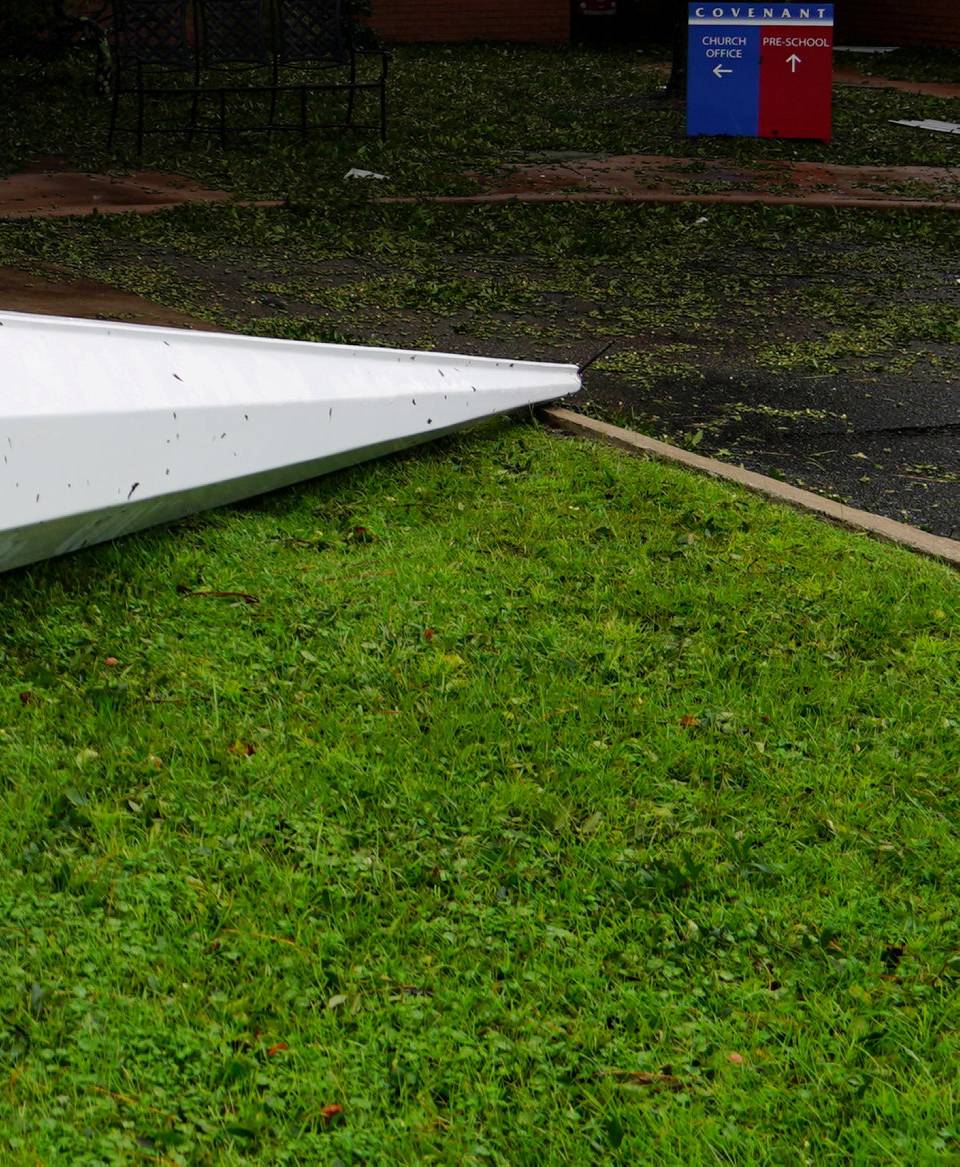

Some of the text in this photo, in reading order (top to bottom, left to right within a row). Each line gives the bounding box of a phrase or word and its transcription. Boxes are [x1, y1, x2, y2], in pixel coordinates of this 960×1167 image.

[695, 7, 826, 18] COVENANT
[702, 36, 747, 46] CHURCH
[763, 37, 830, 47] PRE-SCHOOL
[706, 49, 742, 58] OFFICE
